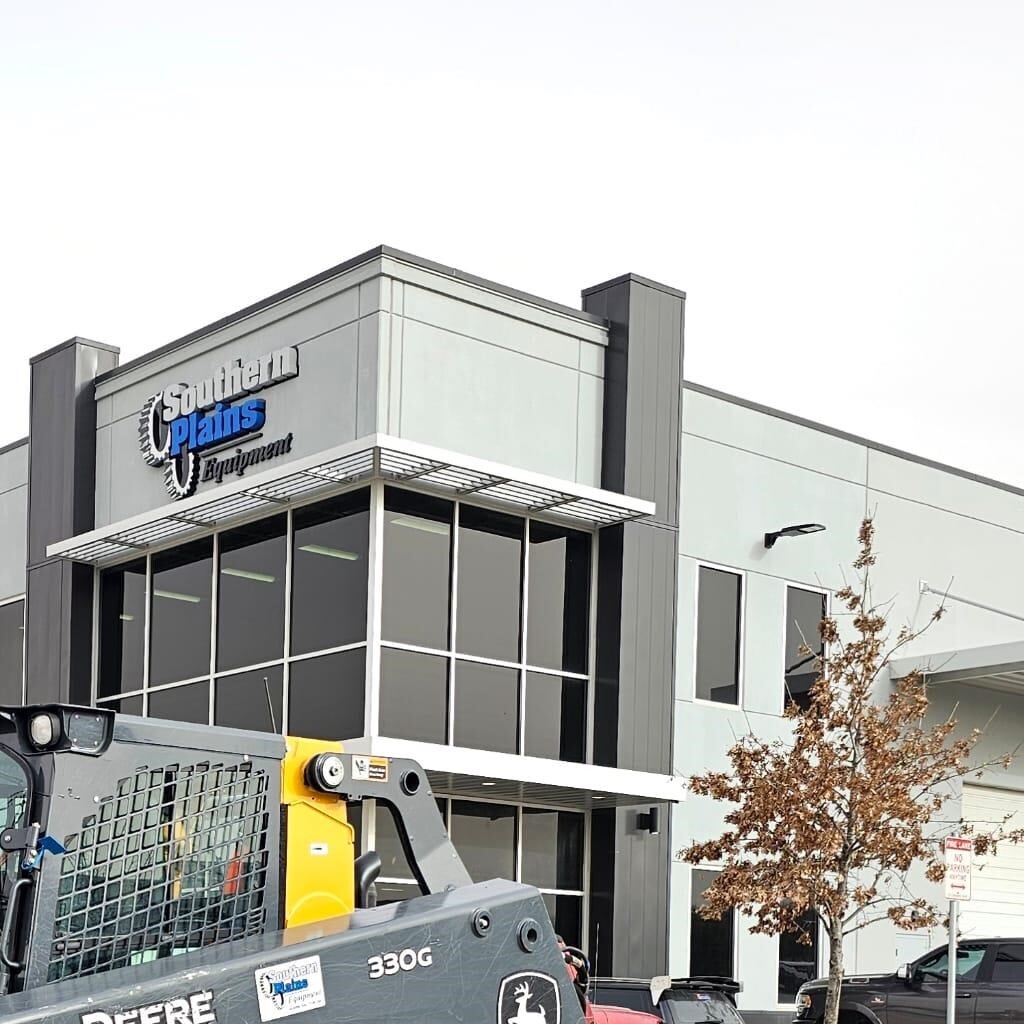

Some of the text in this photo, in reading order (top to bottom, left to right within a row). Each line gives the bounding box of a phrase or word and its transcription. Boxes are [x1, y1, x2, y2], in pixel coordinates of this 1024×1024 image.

[162, 346, 299, 422] Southern
[170, 399, 266, 457] Plains
[201, 432, 294, 483] Equipment
[953, 853, 963, 863] NO
[269, 962, 319, 982] Southern
[367, 946, 433, 979] 330G
[273, 978, 308, 995] Plains
